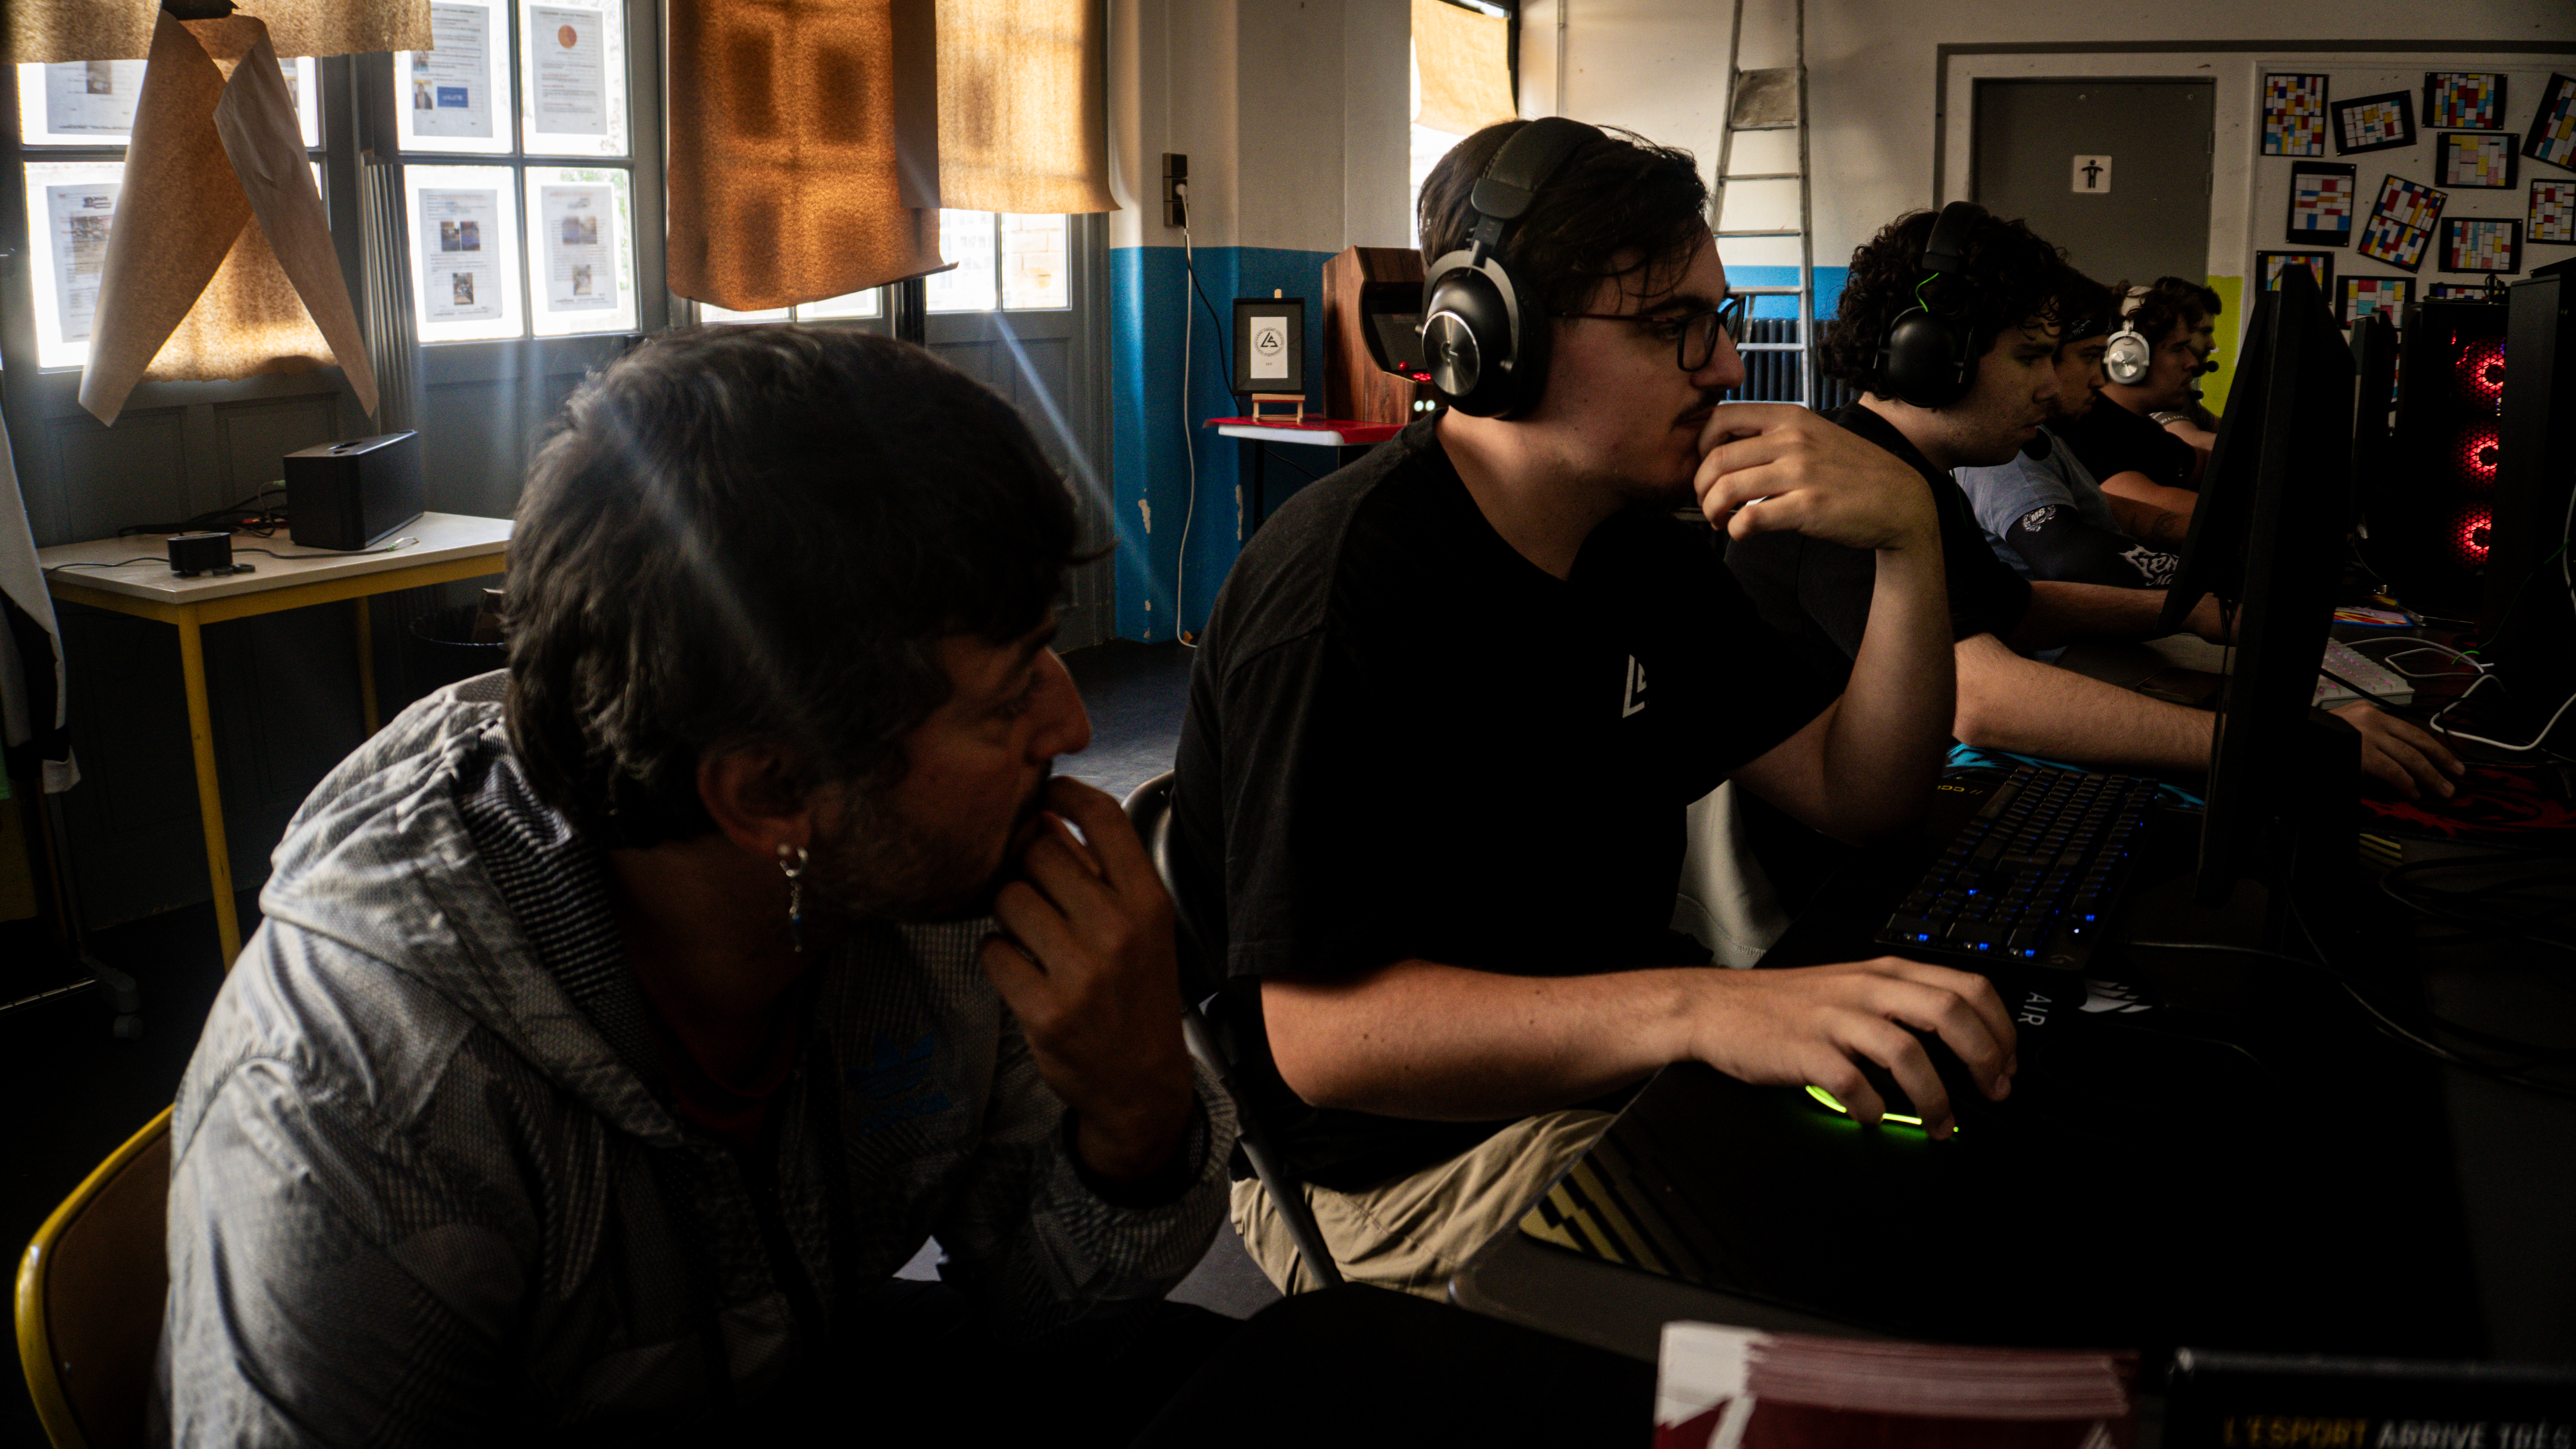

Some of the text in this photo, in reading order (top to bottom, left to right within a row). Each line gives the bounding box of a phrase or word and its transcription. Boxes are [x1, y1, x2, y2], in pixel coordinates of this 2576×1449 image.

[2118, 543, 2179, 579] Gen
[860, 1093, 953, 1137] adidas
[2374, 1418, 2489, 1449] ARRIVE
